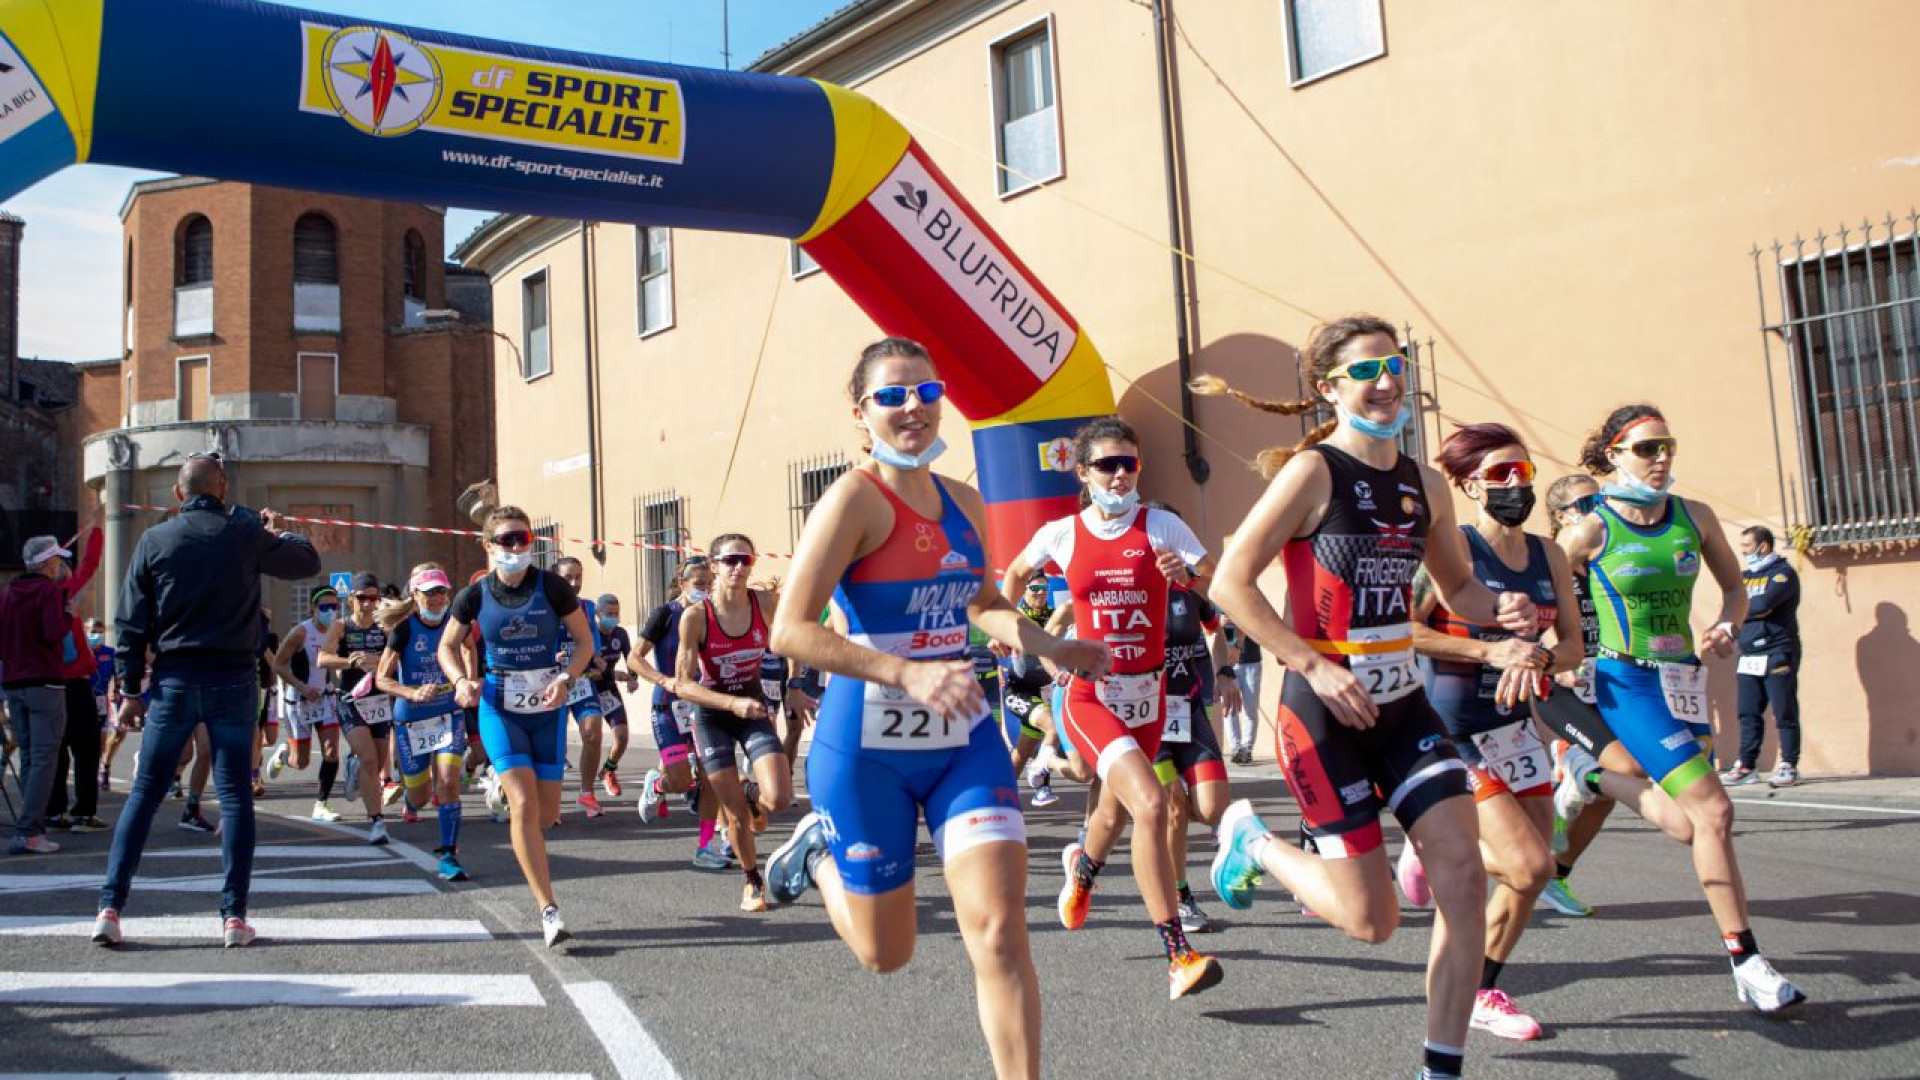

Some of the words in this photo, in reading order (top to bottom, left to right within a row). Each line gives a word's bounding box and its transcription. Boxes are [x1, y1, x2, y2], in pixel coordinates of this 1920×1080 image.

[525, 71, 668, 112] SPORT
[449, 90, 669, 144] SPECIALIST
[442, 149, 664, 189] www.df-sportspecialist.it
[924, 208, 1061, 363] BLUFRIDA
[1089, 590, 1149, 607] GARBARINO
[1357, 587, 1408, 616] ITA
[918, 610, 957, 631] ITA
[1091, 609, 1153, 630] ITA
[1650, 614, 1680, 633] ITA
[515, 655, 531, 663] ITA
[513, 692, 548, 709] 26
[1283, 724, 1318, 806] VENUS
